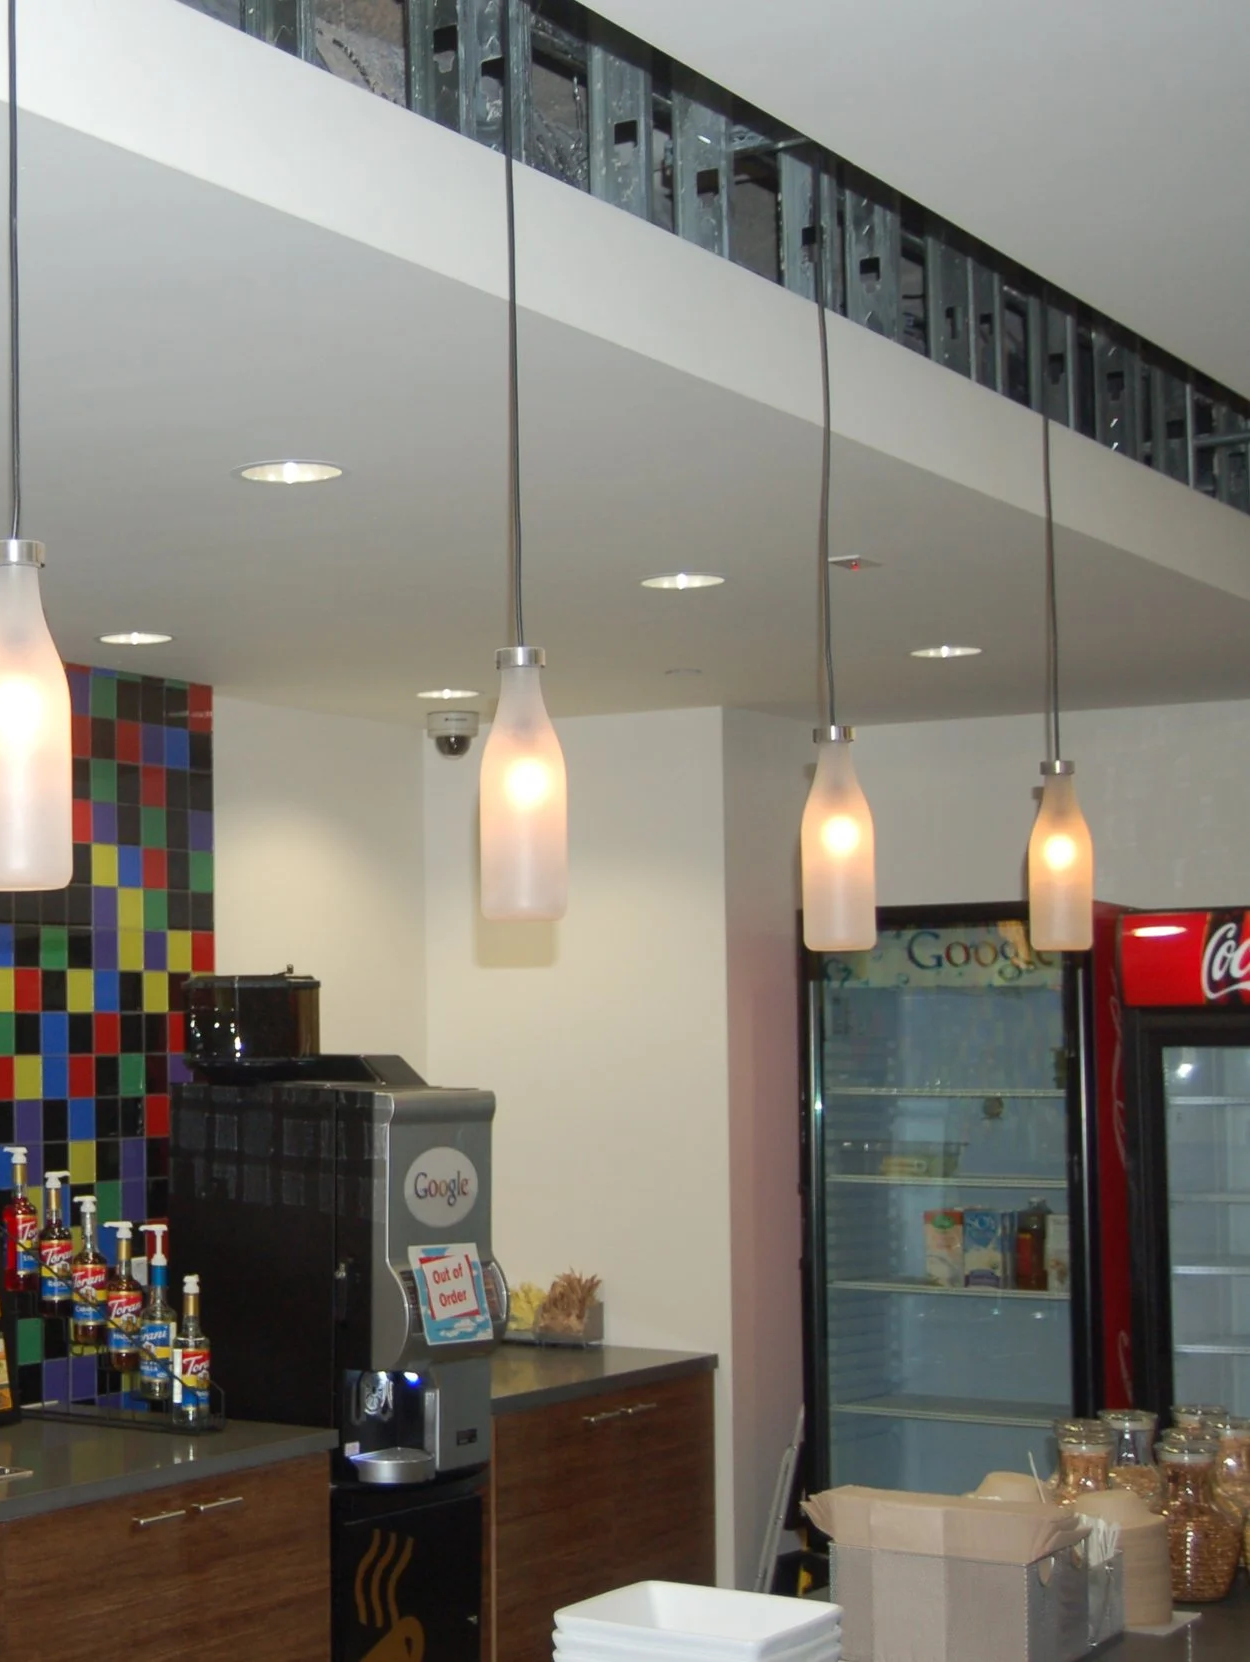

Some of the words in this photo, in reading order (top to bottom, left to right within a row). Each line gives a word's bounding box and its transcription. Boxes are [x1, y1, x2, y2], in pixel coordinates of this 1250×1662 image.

[414, 1170, 470, 1207] Google
[72, 1269, 106, 1288] Torani
[432, 1267, 451, 1285] Out
[452, 1262, 463, 1279] of
[438, 1289, 468, 1307] Order
